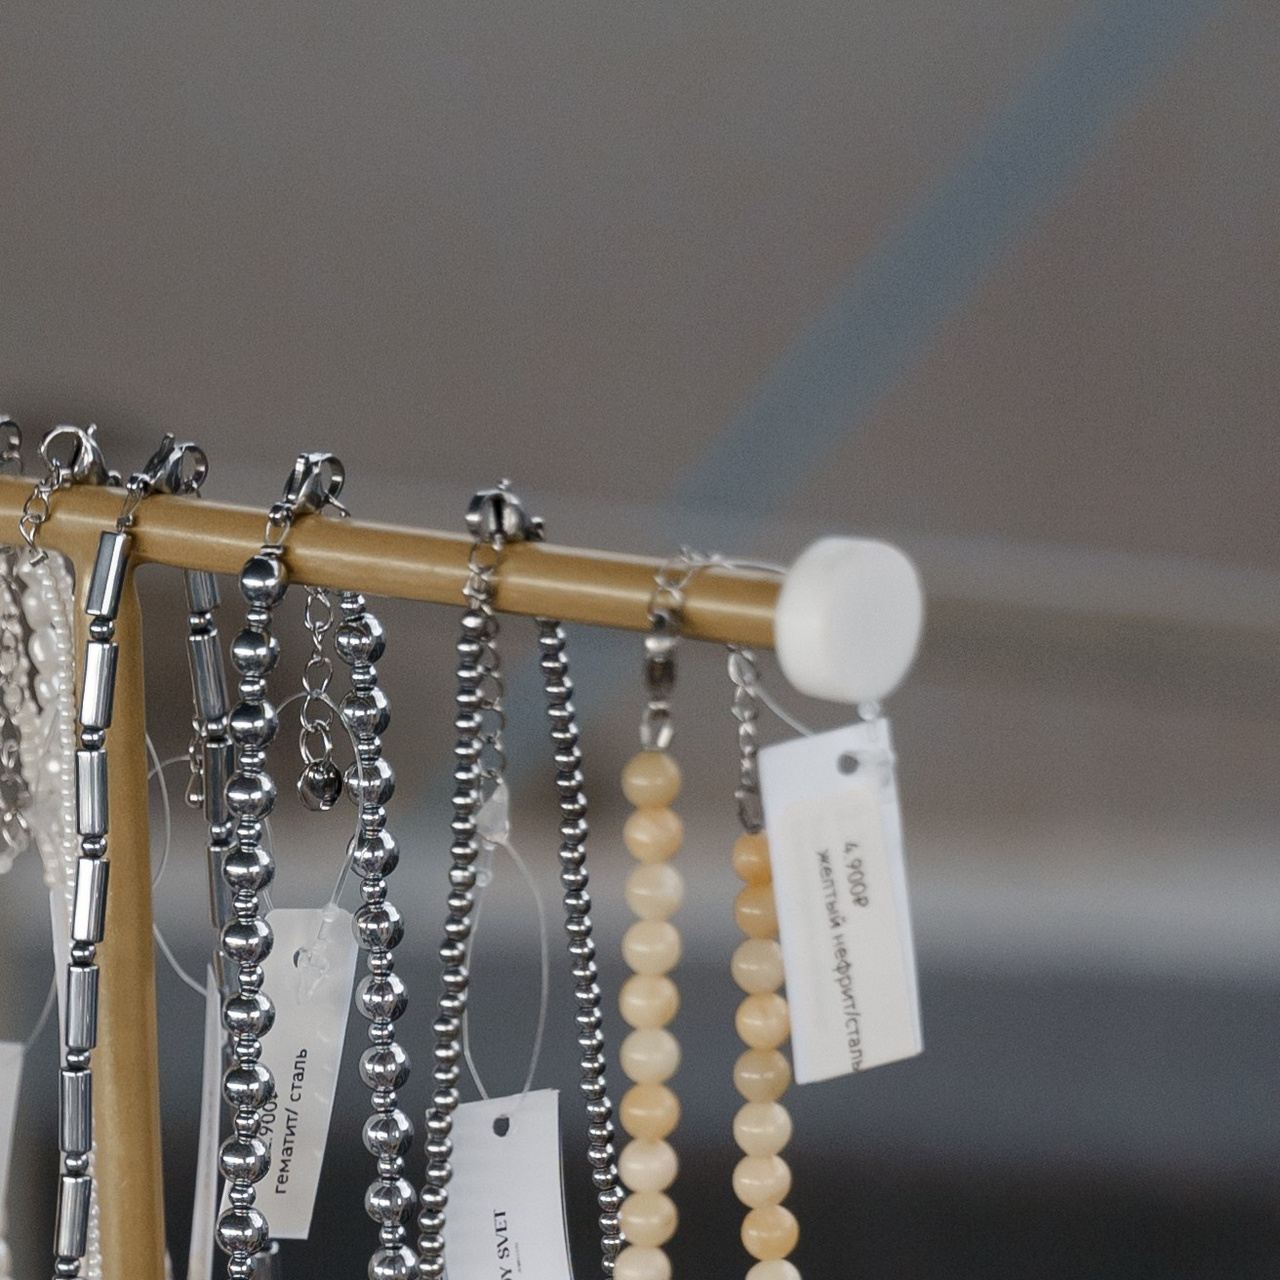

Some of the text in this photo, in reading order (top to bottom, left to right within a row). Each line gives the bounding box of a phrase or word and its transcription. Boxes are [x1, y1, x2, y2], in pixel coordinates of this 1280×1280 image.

[815, 847, 863, 1072] желтый нефрит/сталь
[275, 1048, 308, 1196] гематит/ сталь
[493, 1208, 512, 1260] SVET
